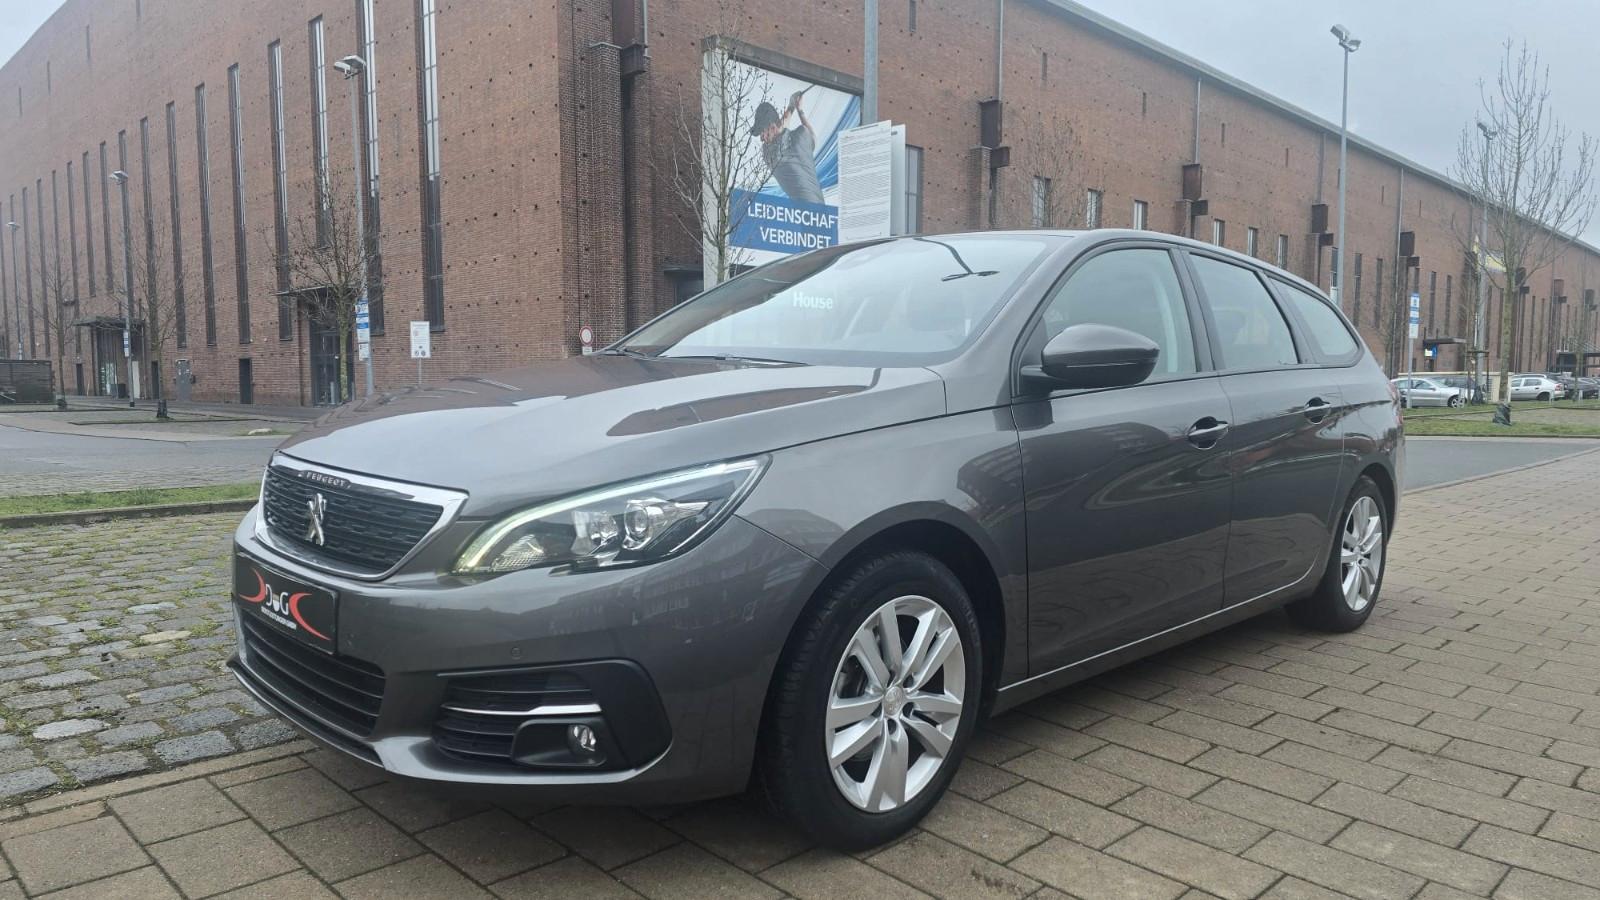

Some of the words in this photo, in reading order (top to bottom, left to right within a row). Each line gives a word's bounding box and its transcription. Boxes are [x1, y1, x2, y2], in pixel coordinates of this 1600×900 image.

[760, 227, 831, 249] VERBINDET
[792, 291, 833, 310] House
[306, 471, 346, 487] PEUGEOT
